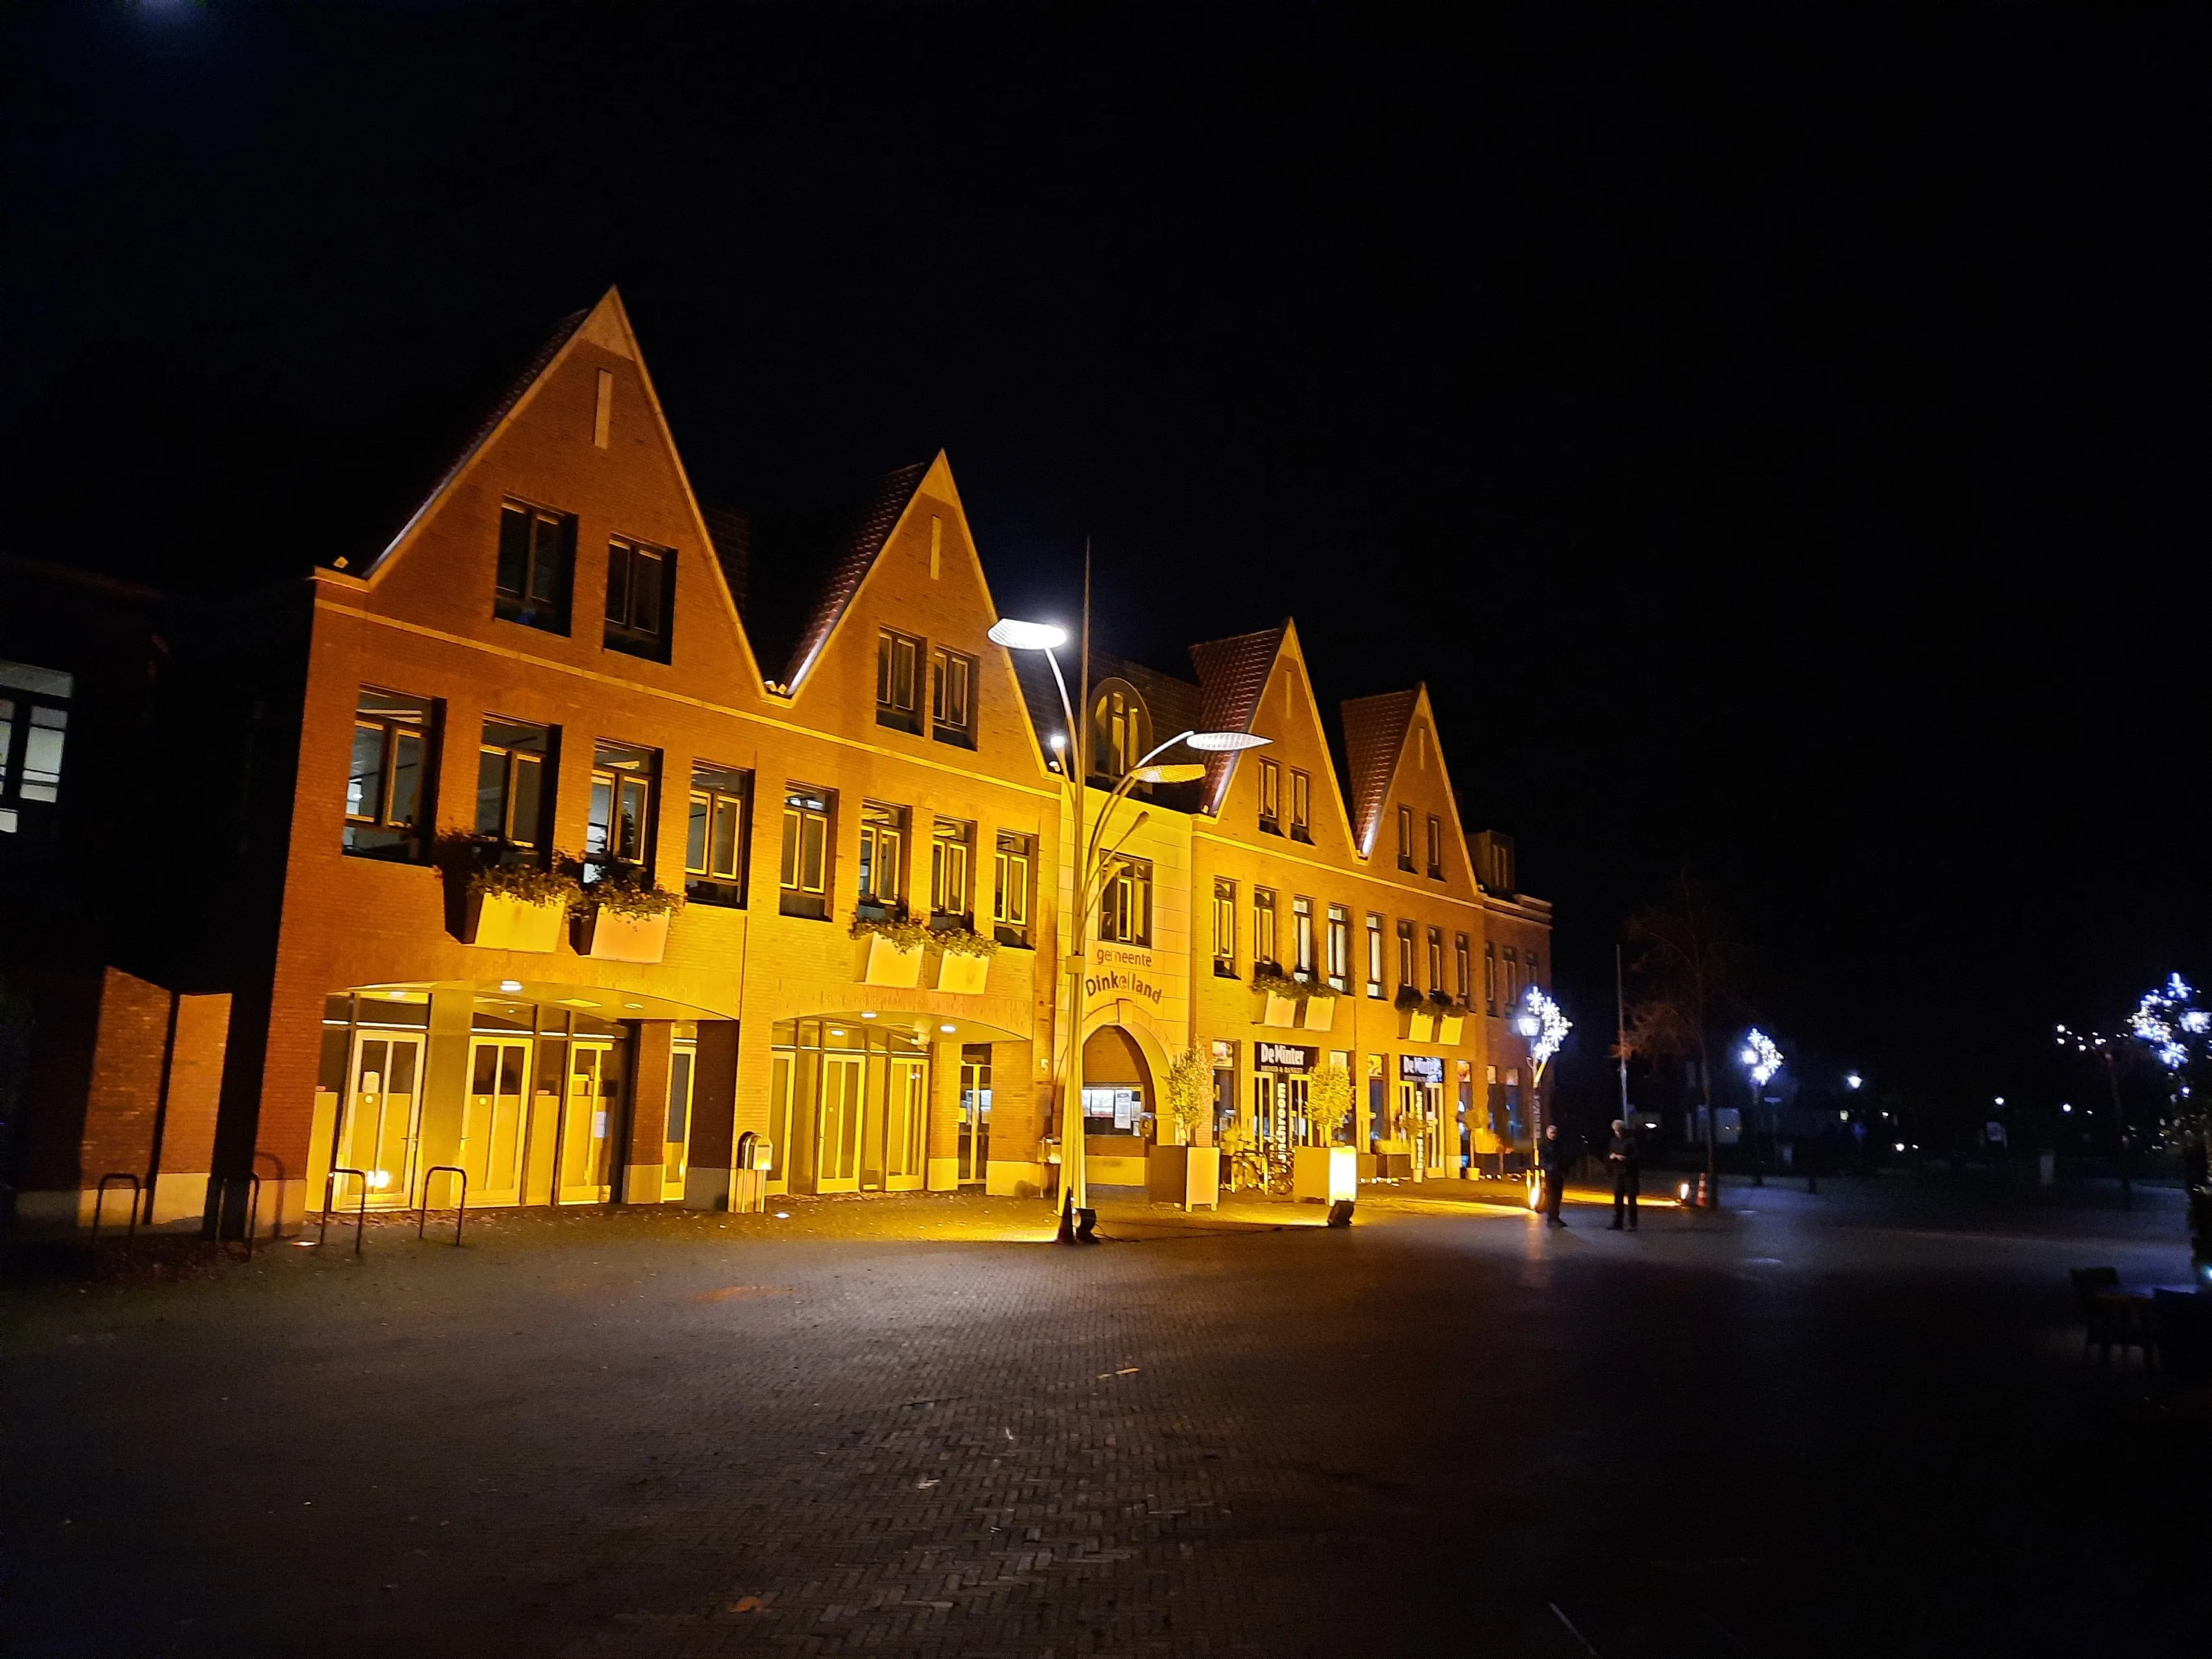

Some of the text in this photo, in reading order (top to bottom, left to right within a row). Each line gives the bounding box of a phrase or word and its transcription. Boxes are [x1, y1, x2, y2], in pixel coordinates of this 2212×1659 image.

[1097, 949, 1152, 967] gemeente
[1086, 970, 1162, 1004] Dinkelland
[1040, 1058, 1050, 1073] 5
